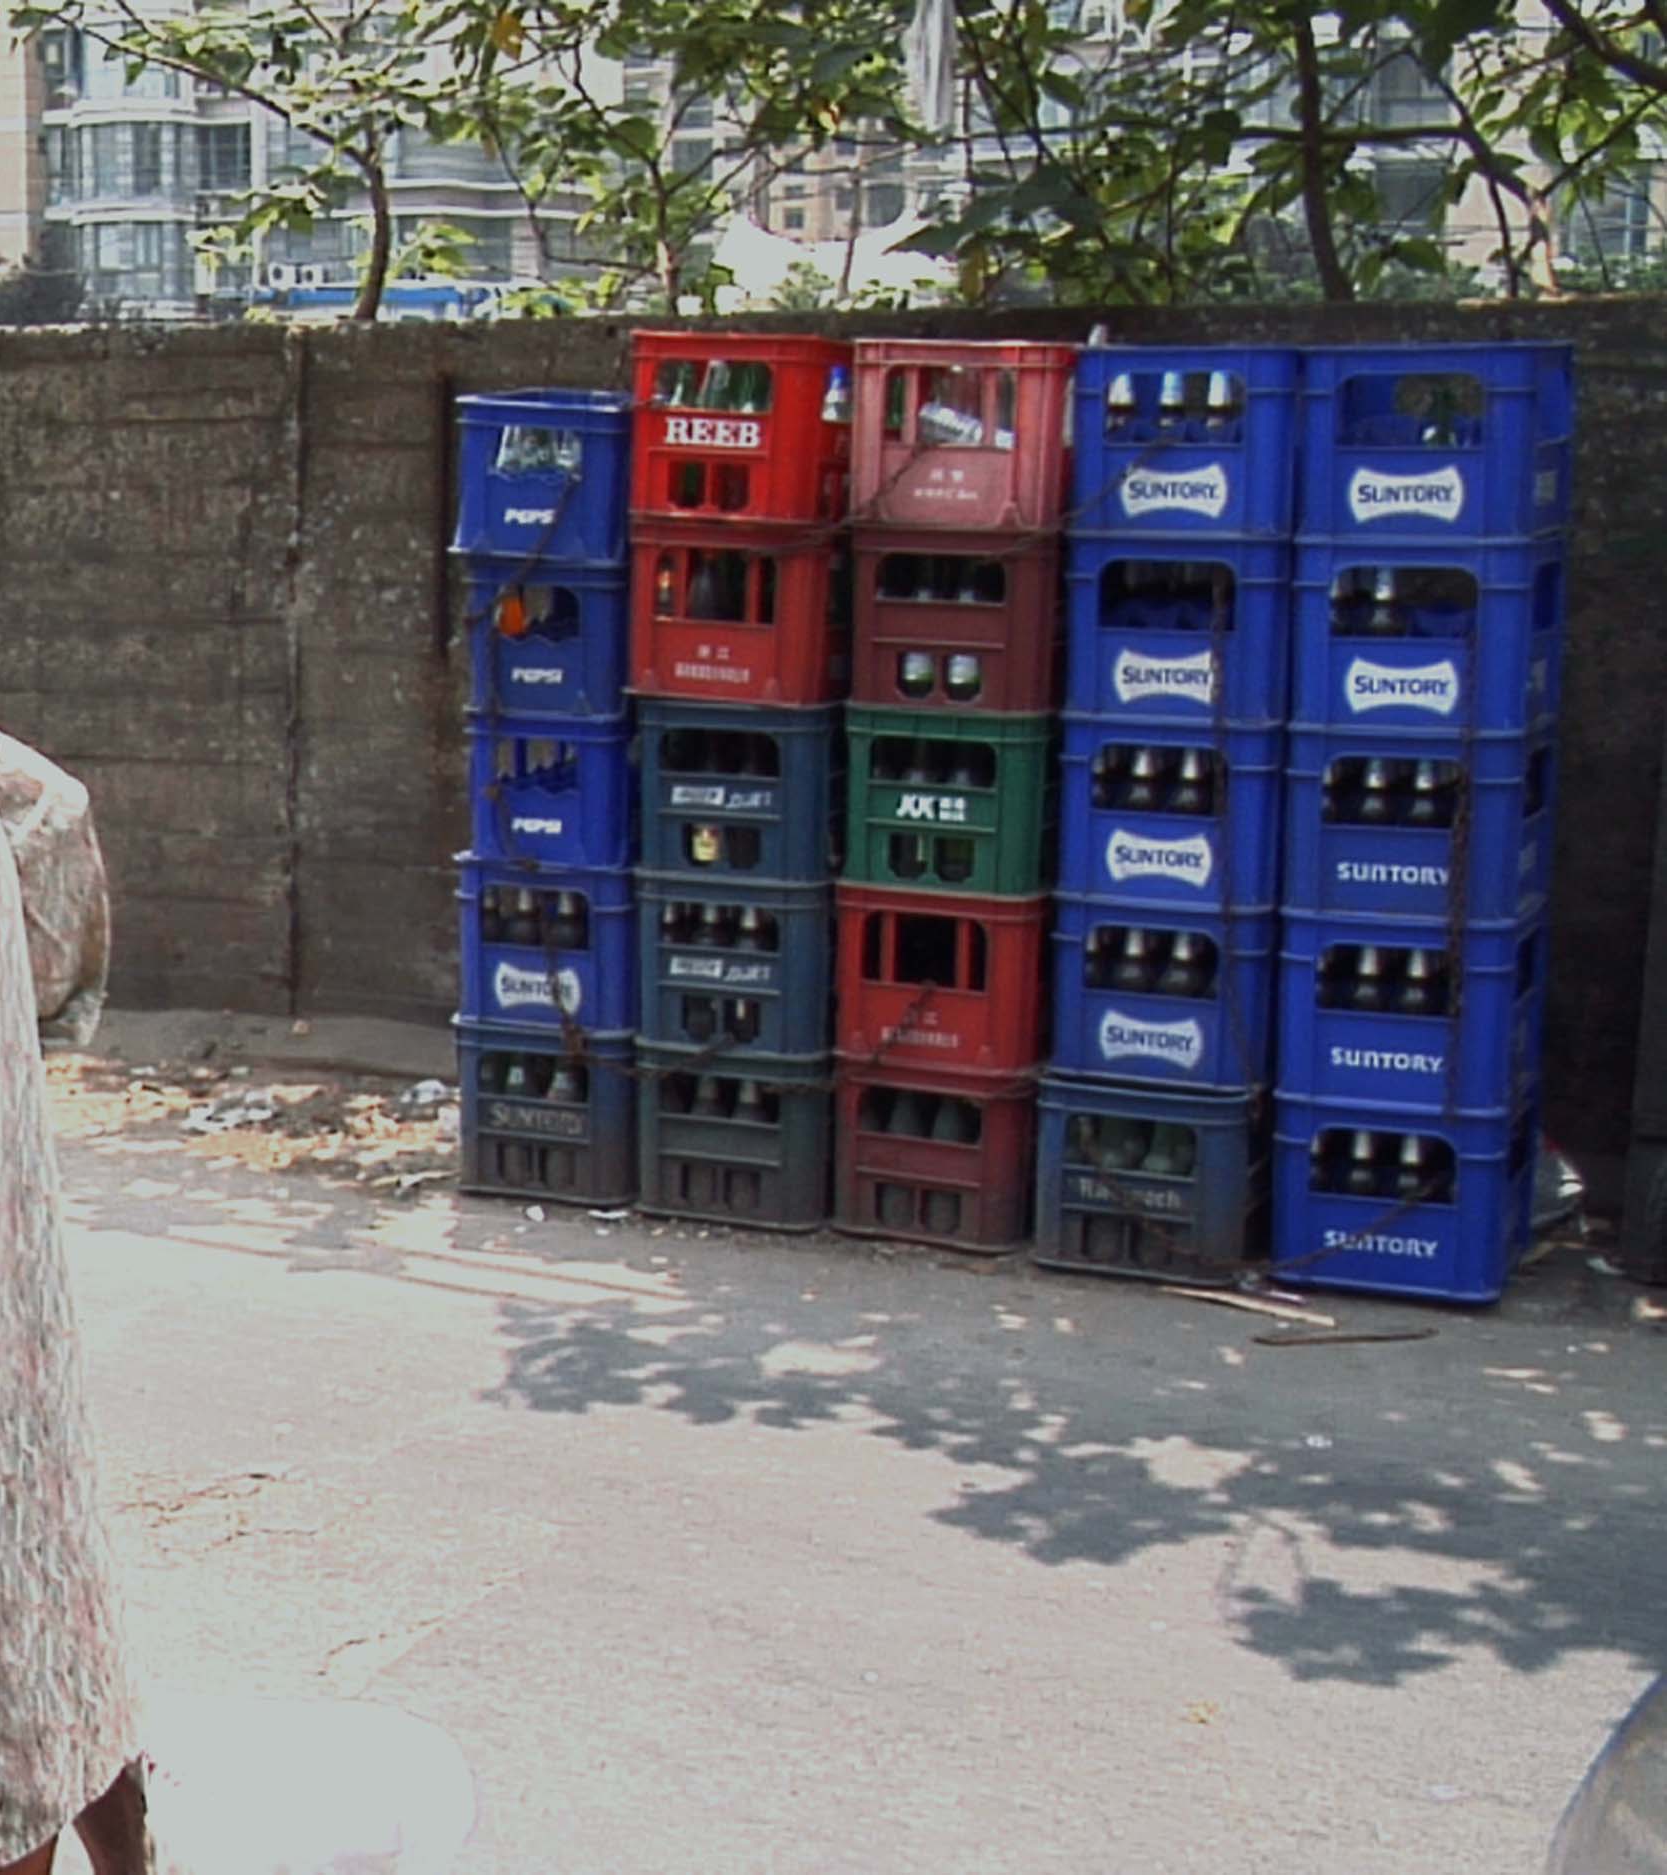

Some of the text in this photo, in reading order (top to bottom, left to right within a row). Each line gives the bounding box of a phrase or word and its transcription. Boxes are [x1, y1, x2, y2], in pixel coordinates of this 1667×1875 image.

[665, 417, 760, 447] REEB
[1128, 480, 1219, 501] SUNTORY
[1358, 483, 1455, 504] SUNTORY
[511, 667, 563, 684] PEPSI
[1122, 664, 1210, 687] SUNTORY
[1354, 675, 1450, 697] SUNTORY
[512, 817, 562, 834] PEPSI
[1114, 845, 1205, 869] SUNTORY
[1104, 1026, 1195, 1052] SUNTORY
